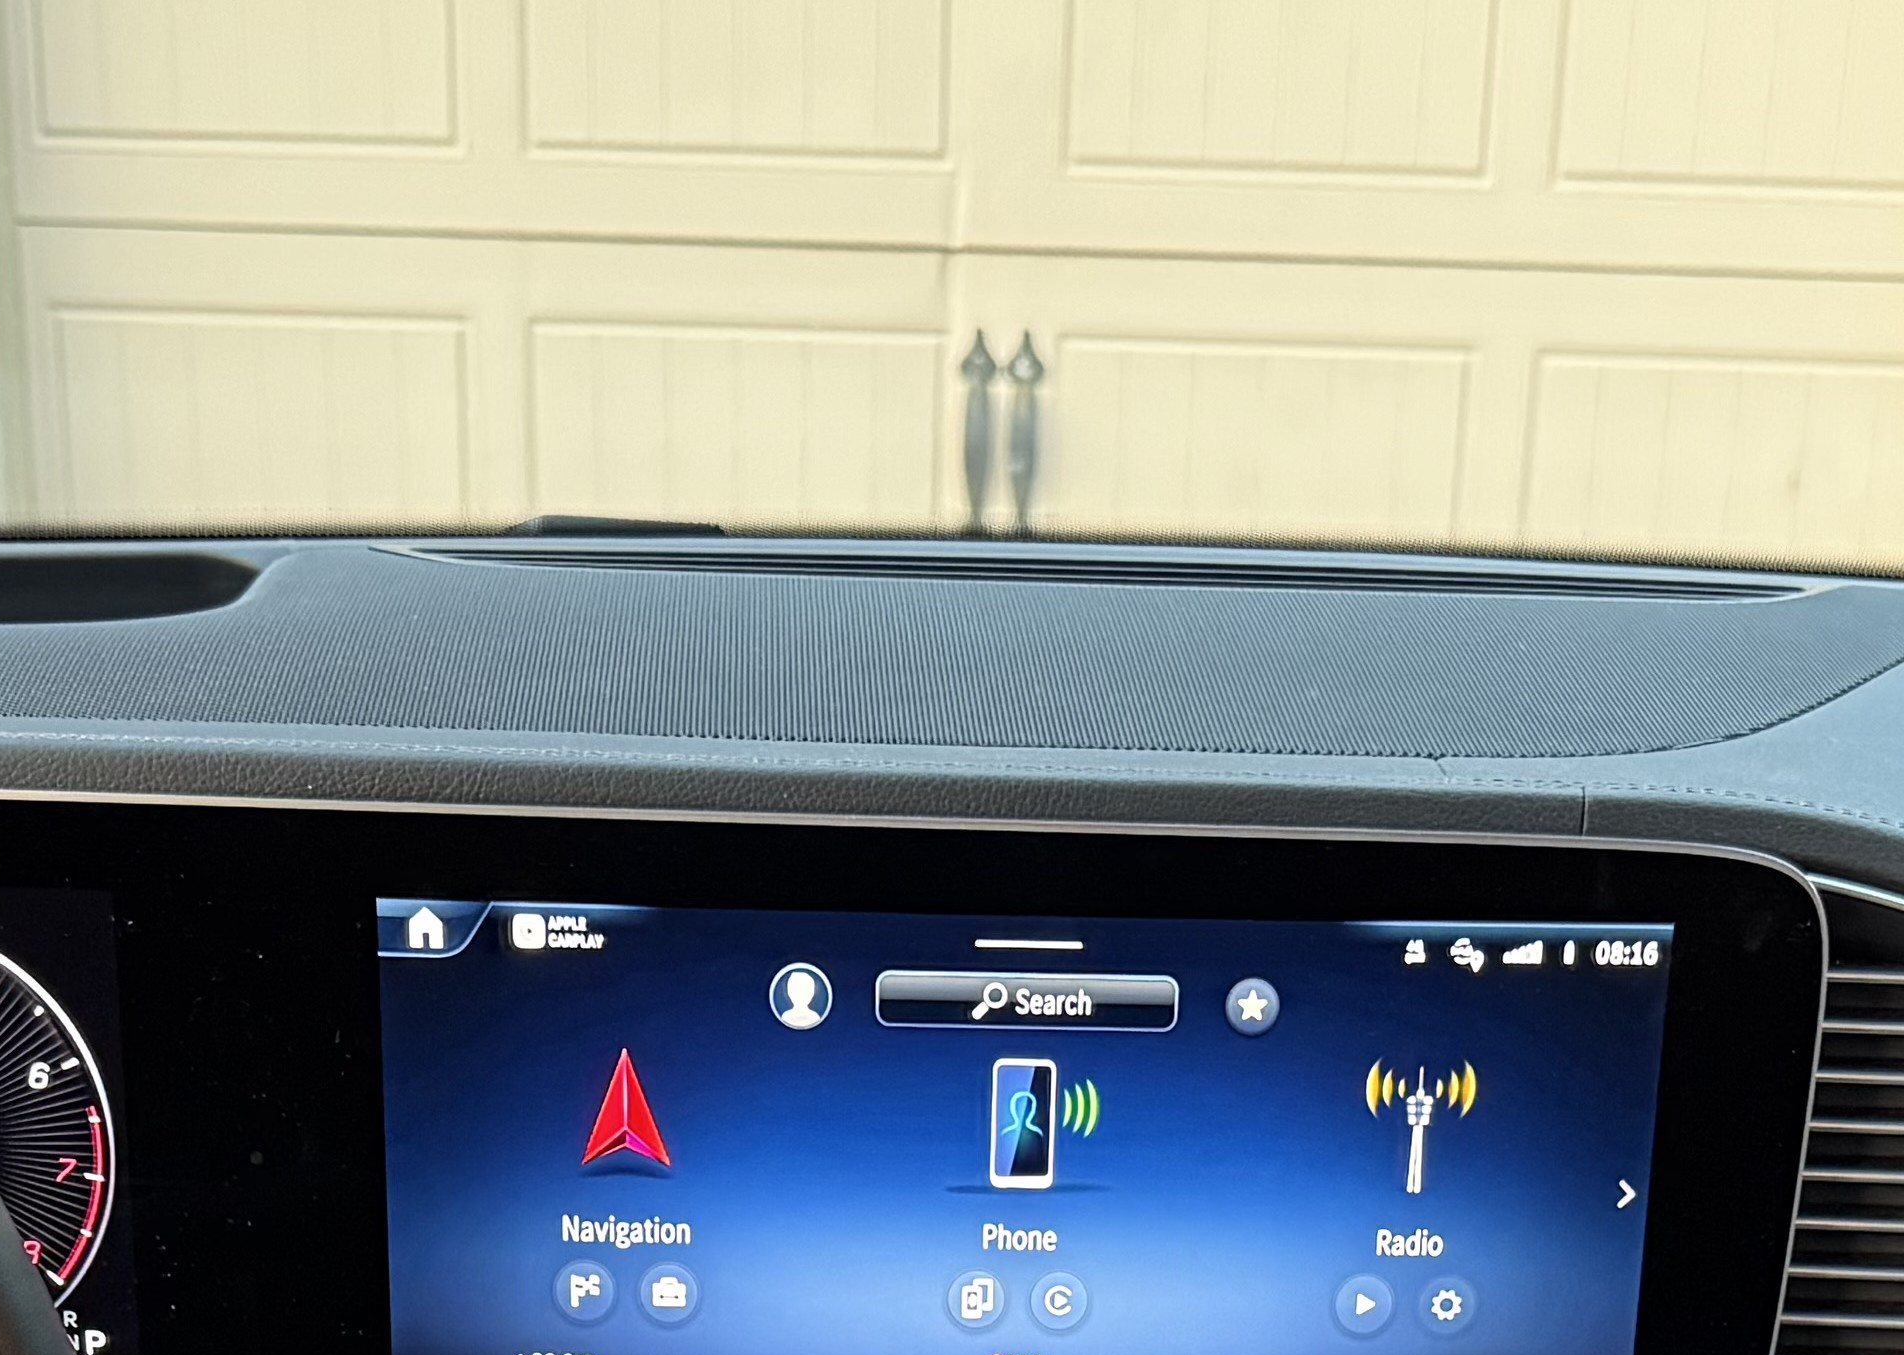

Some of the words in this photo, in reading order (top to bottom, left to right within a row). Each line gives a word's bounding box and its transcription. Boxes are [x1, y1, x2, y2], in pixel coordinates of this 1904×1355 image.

[547, 915, 588, 932] APPLE
[547, 932, 605, 949] CARPLAY
[1595, 940, 1659, 966] 08:16
[1015, 986, 1090, 1016] Search
[27, 1061, 51, 1090] 6
[57, 1159, 77, 1182] 7
[561, 1214, 692, 1248] Navigation
[982, 1224, 1058, 1251] Phone
[1376, 1229, 1444, 1258] Radio
[63, 1310, 78, 1328] R
[84, 1329, 107, 1355] P
